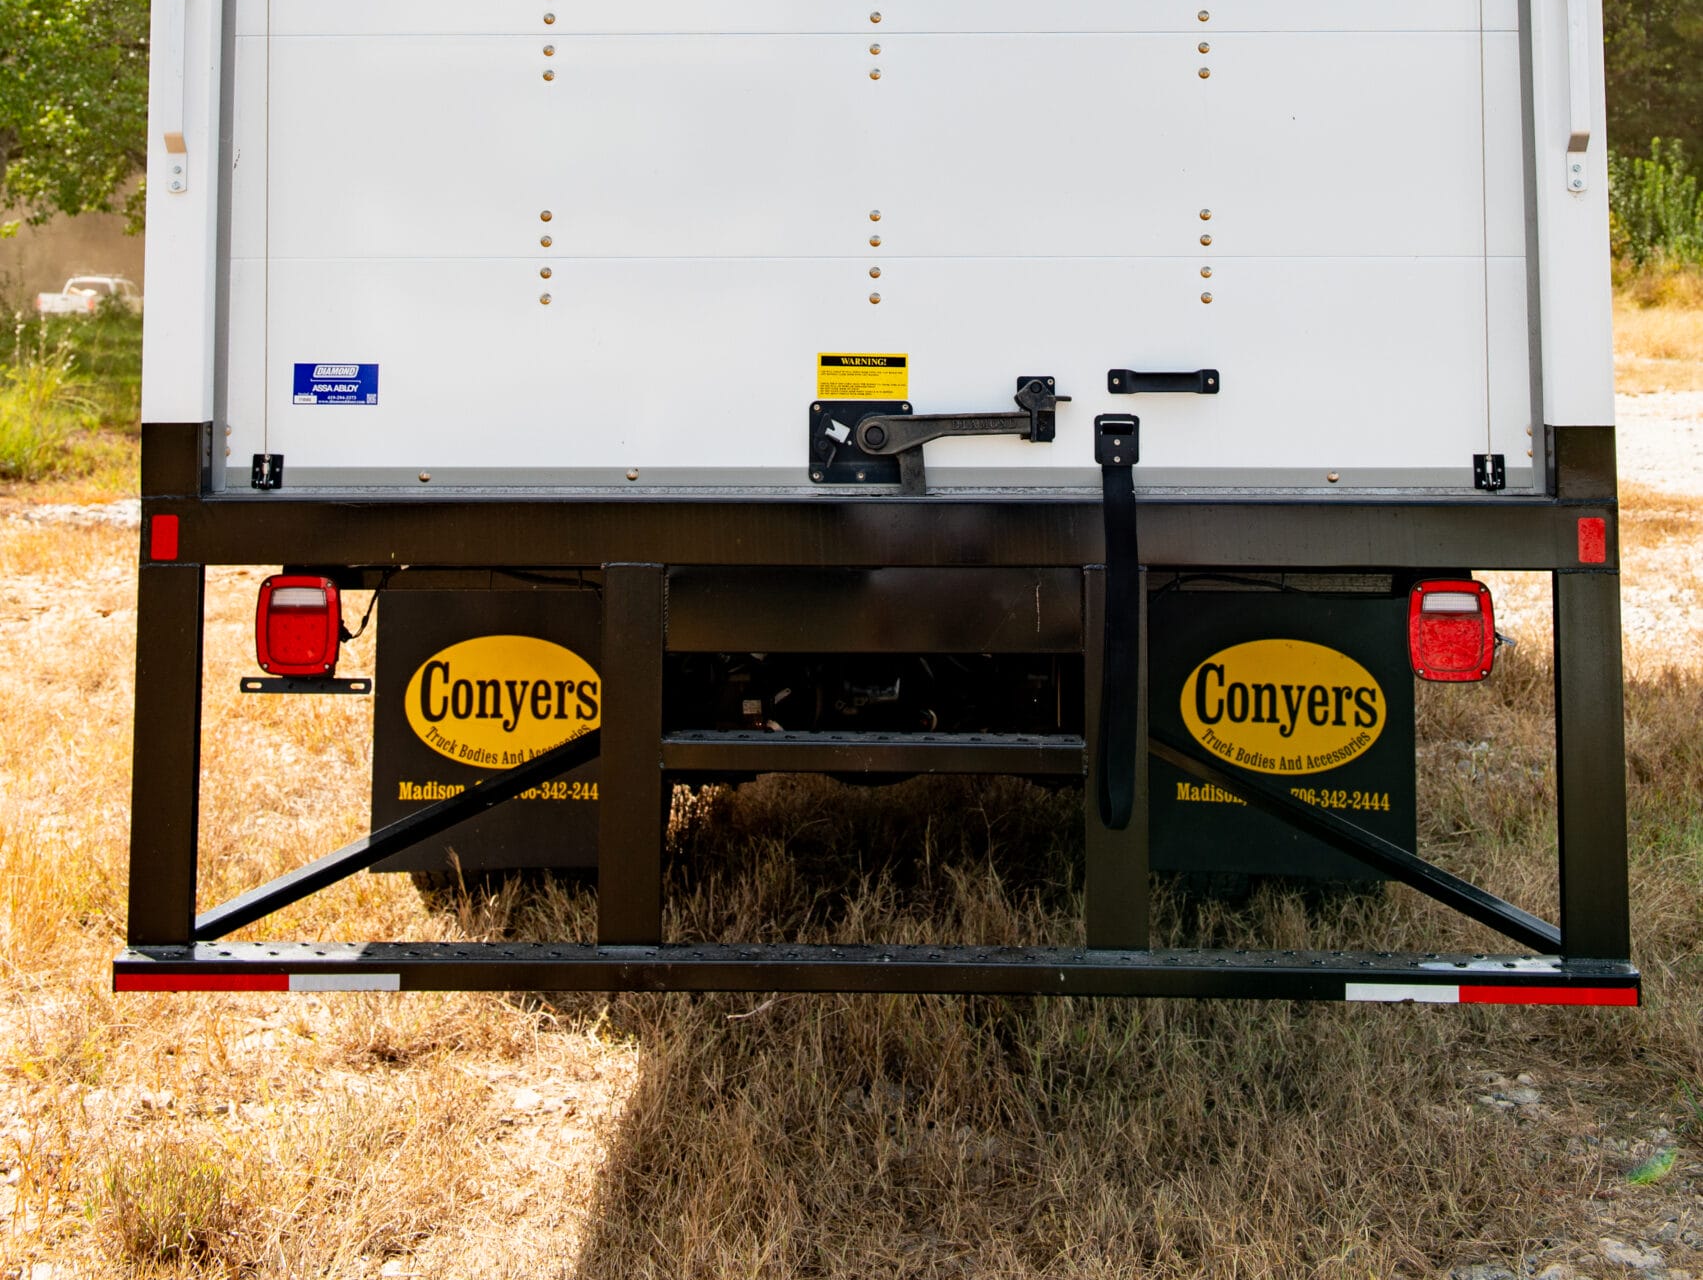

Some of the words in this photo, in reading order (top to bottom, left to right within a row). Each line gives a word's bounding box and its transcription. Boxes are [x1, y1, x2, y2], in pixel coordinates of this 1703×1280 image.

[317, 367, 356, 376] DIAMOND
[841, 357, 887, 366] WARNING!
[312, 384, 333, 392] ASSA
[334, 384, 359, 392] ABLOY
[420, 660, 598, 732] Conyers
[1195, 663, 1378, 738] Conyers
[424, 726, 457, 754] Truck
[459, 744, 498, 764] Bodies
[501, 750, 525, 766] And
[1201, 728, 1234, 757] Truck
[1236, 747, 1276, 770] Bodies
[1279, 755, 1303, 771] And
[1306, 731, 1372, 770] Accessories
[1290, 787, 1390, 811] 706-342-2444
